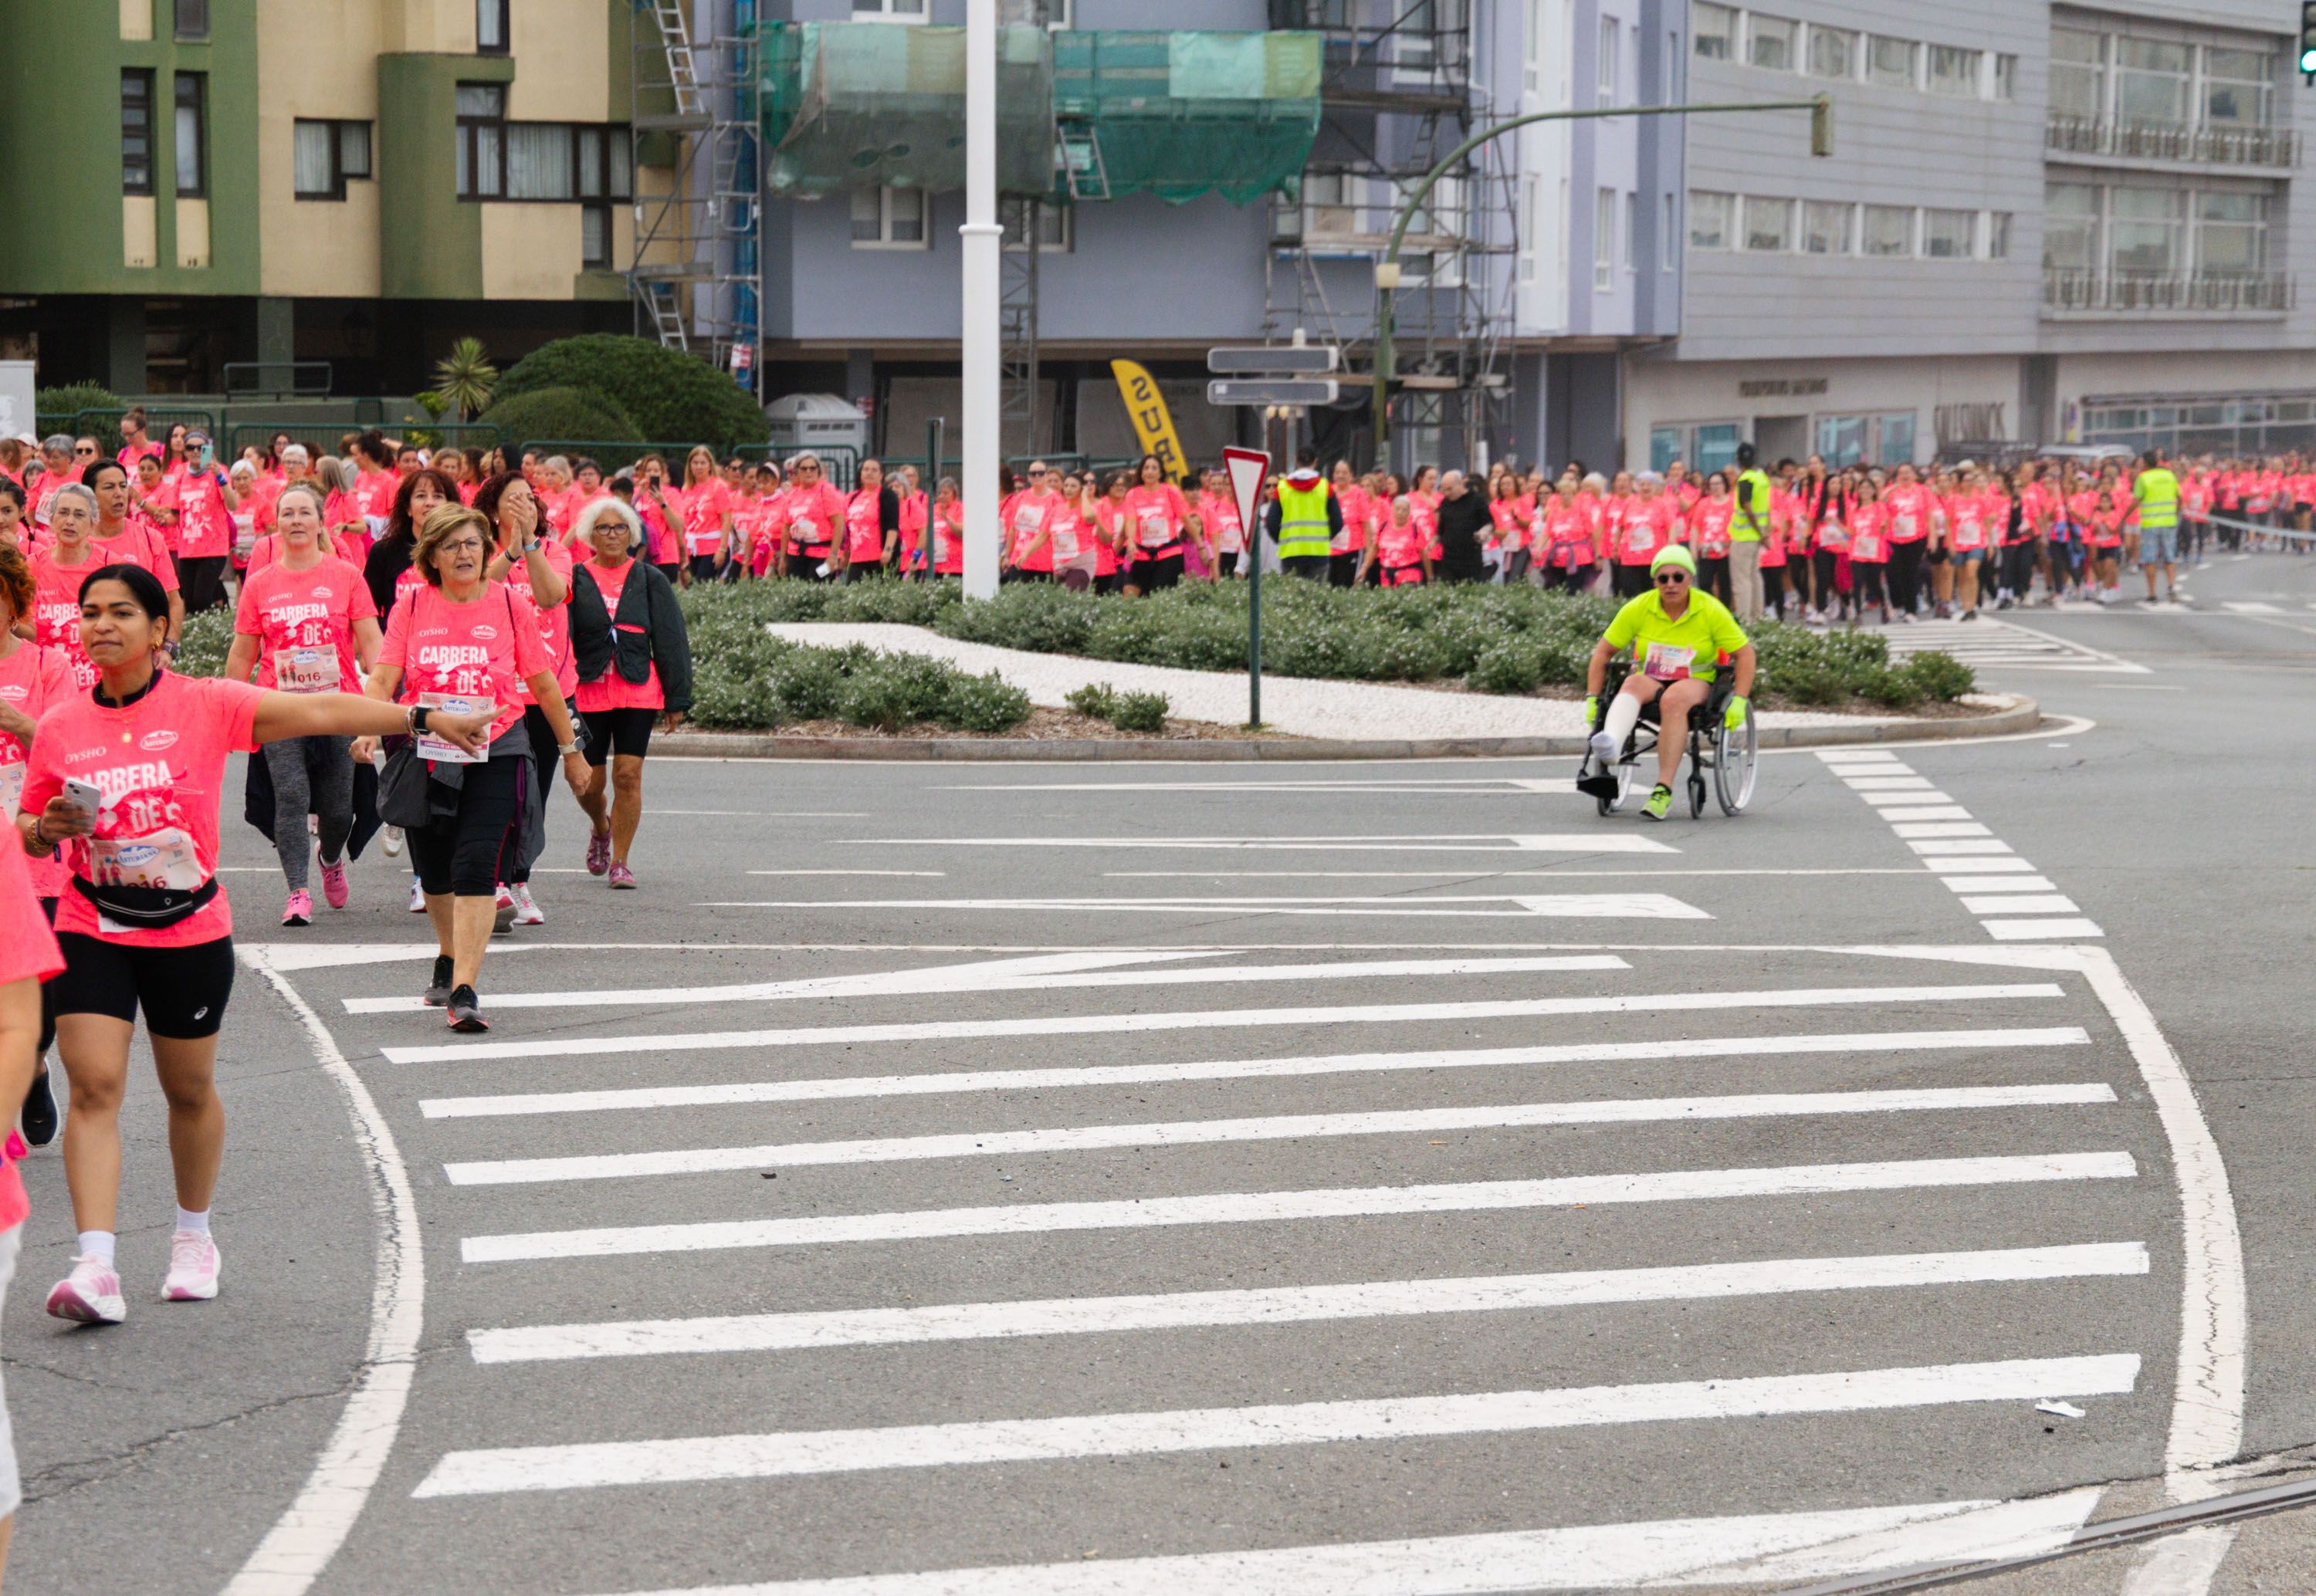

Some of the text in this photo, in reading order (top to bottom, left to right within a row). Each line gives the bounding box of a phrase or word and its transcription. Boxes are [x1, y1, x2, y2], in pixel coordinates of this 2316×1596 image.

[39, 604, 82, 620] CARRE
[271, 604, 329, 623] CARRERA
[419, 627, 449, 637] OYSHO
[419, 645, 489, 664] CARRERA
[297, 672, 320, 683] 016
[65, 746, 107, 765] OYSHO
[73, 759, 174, 797] ARRERA
[118, 850, 157, 864] ASTURIANA
